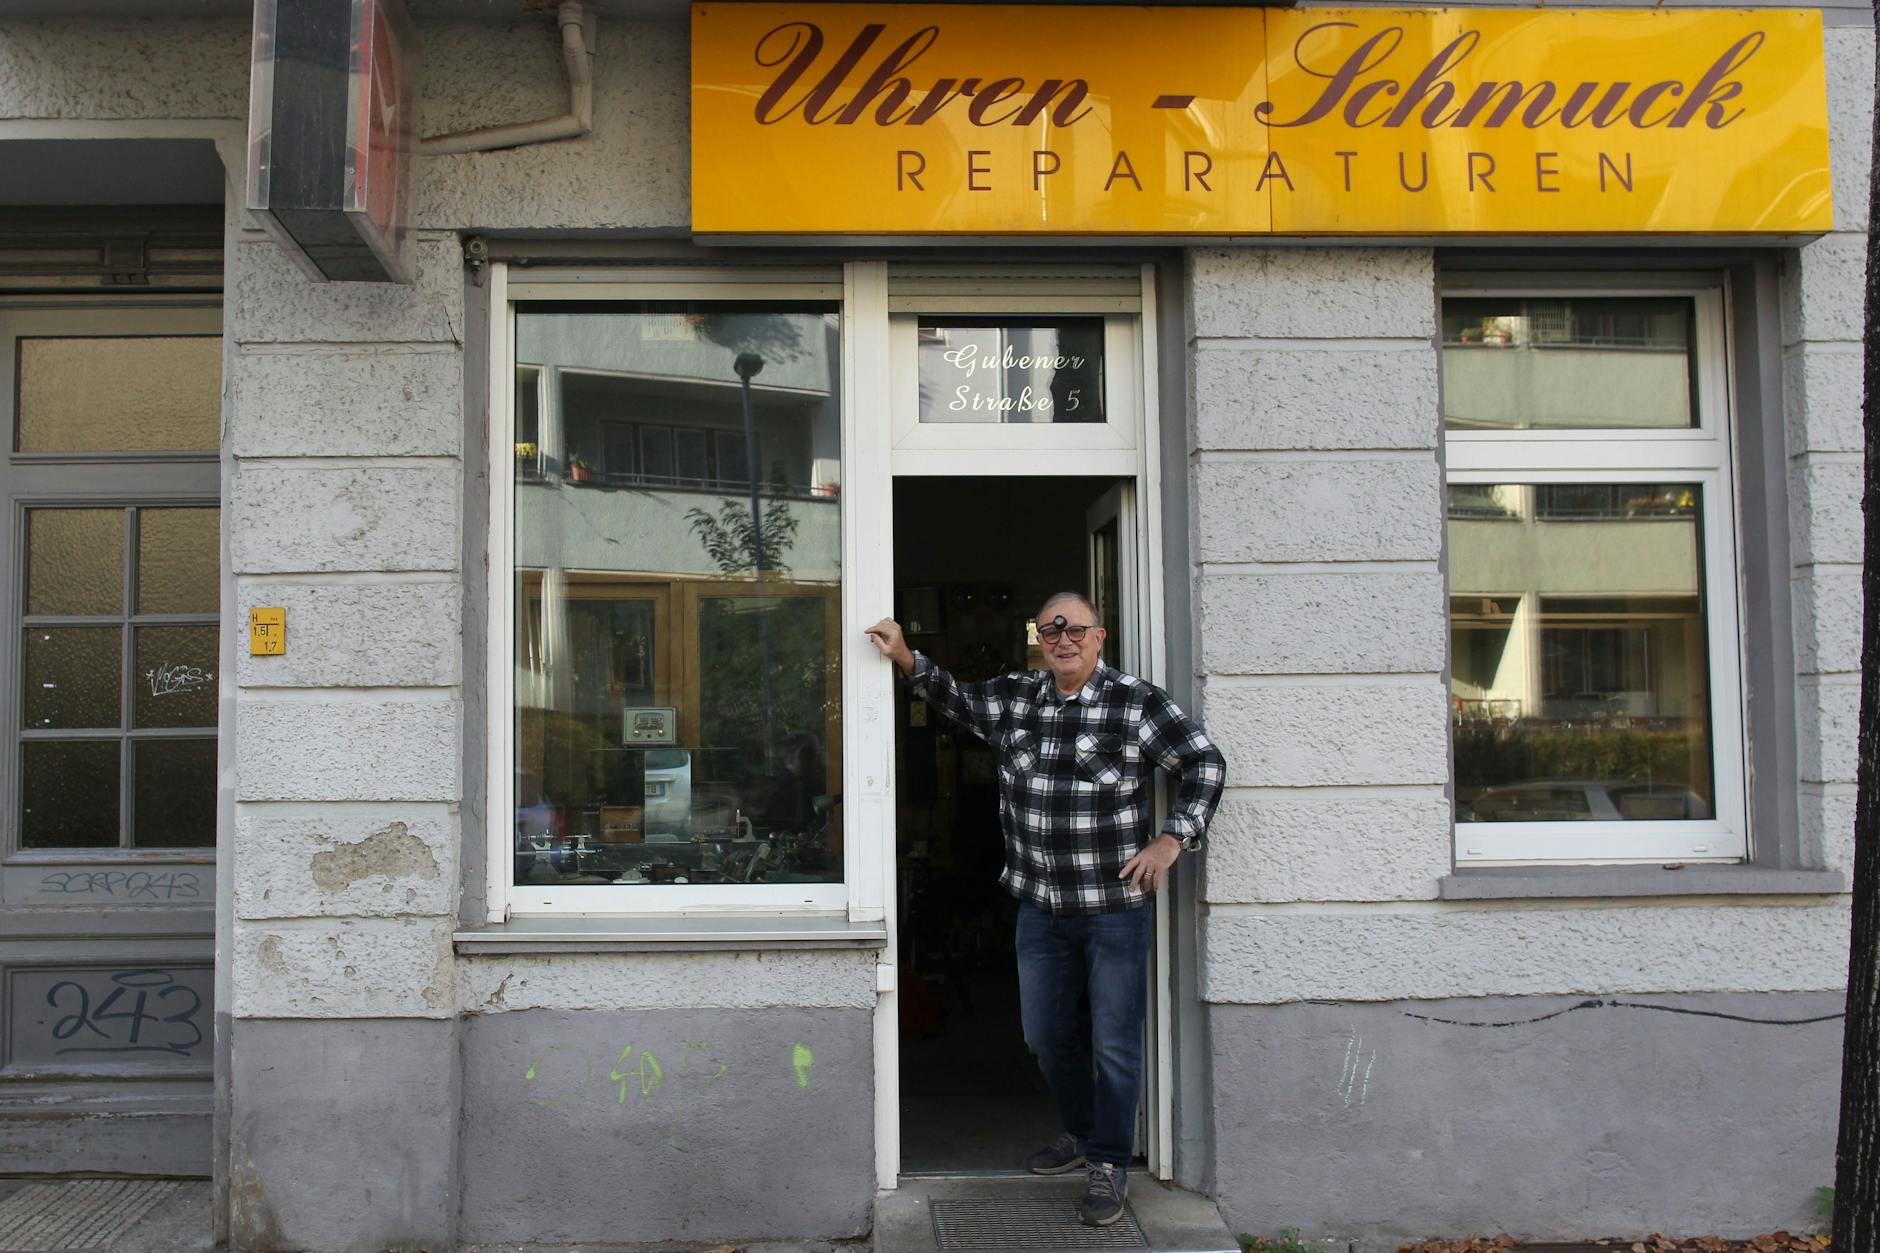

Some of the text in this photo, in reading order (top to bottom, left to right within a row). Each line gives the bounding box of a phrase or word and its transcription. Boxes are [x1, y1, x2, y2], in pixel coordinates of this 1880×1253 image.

[755, 22, 1093, 127] Uhren
[1254, 22, 1765, 129] Schmuck
[897, 150, 1634, 193] REPARATUREN
[943, 343, 1085, 378] Gubener
[949, 385, 1081, 412] Straße 5
[47, 981, 202, 1049] 243
